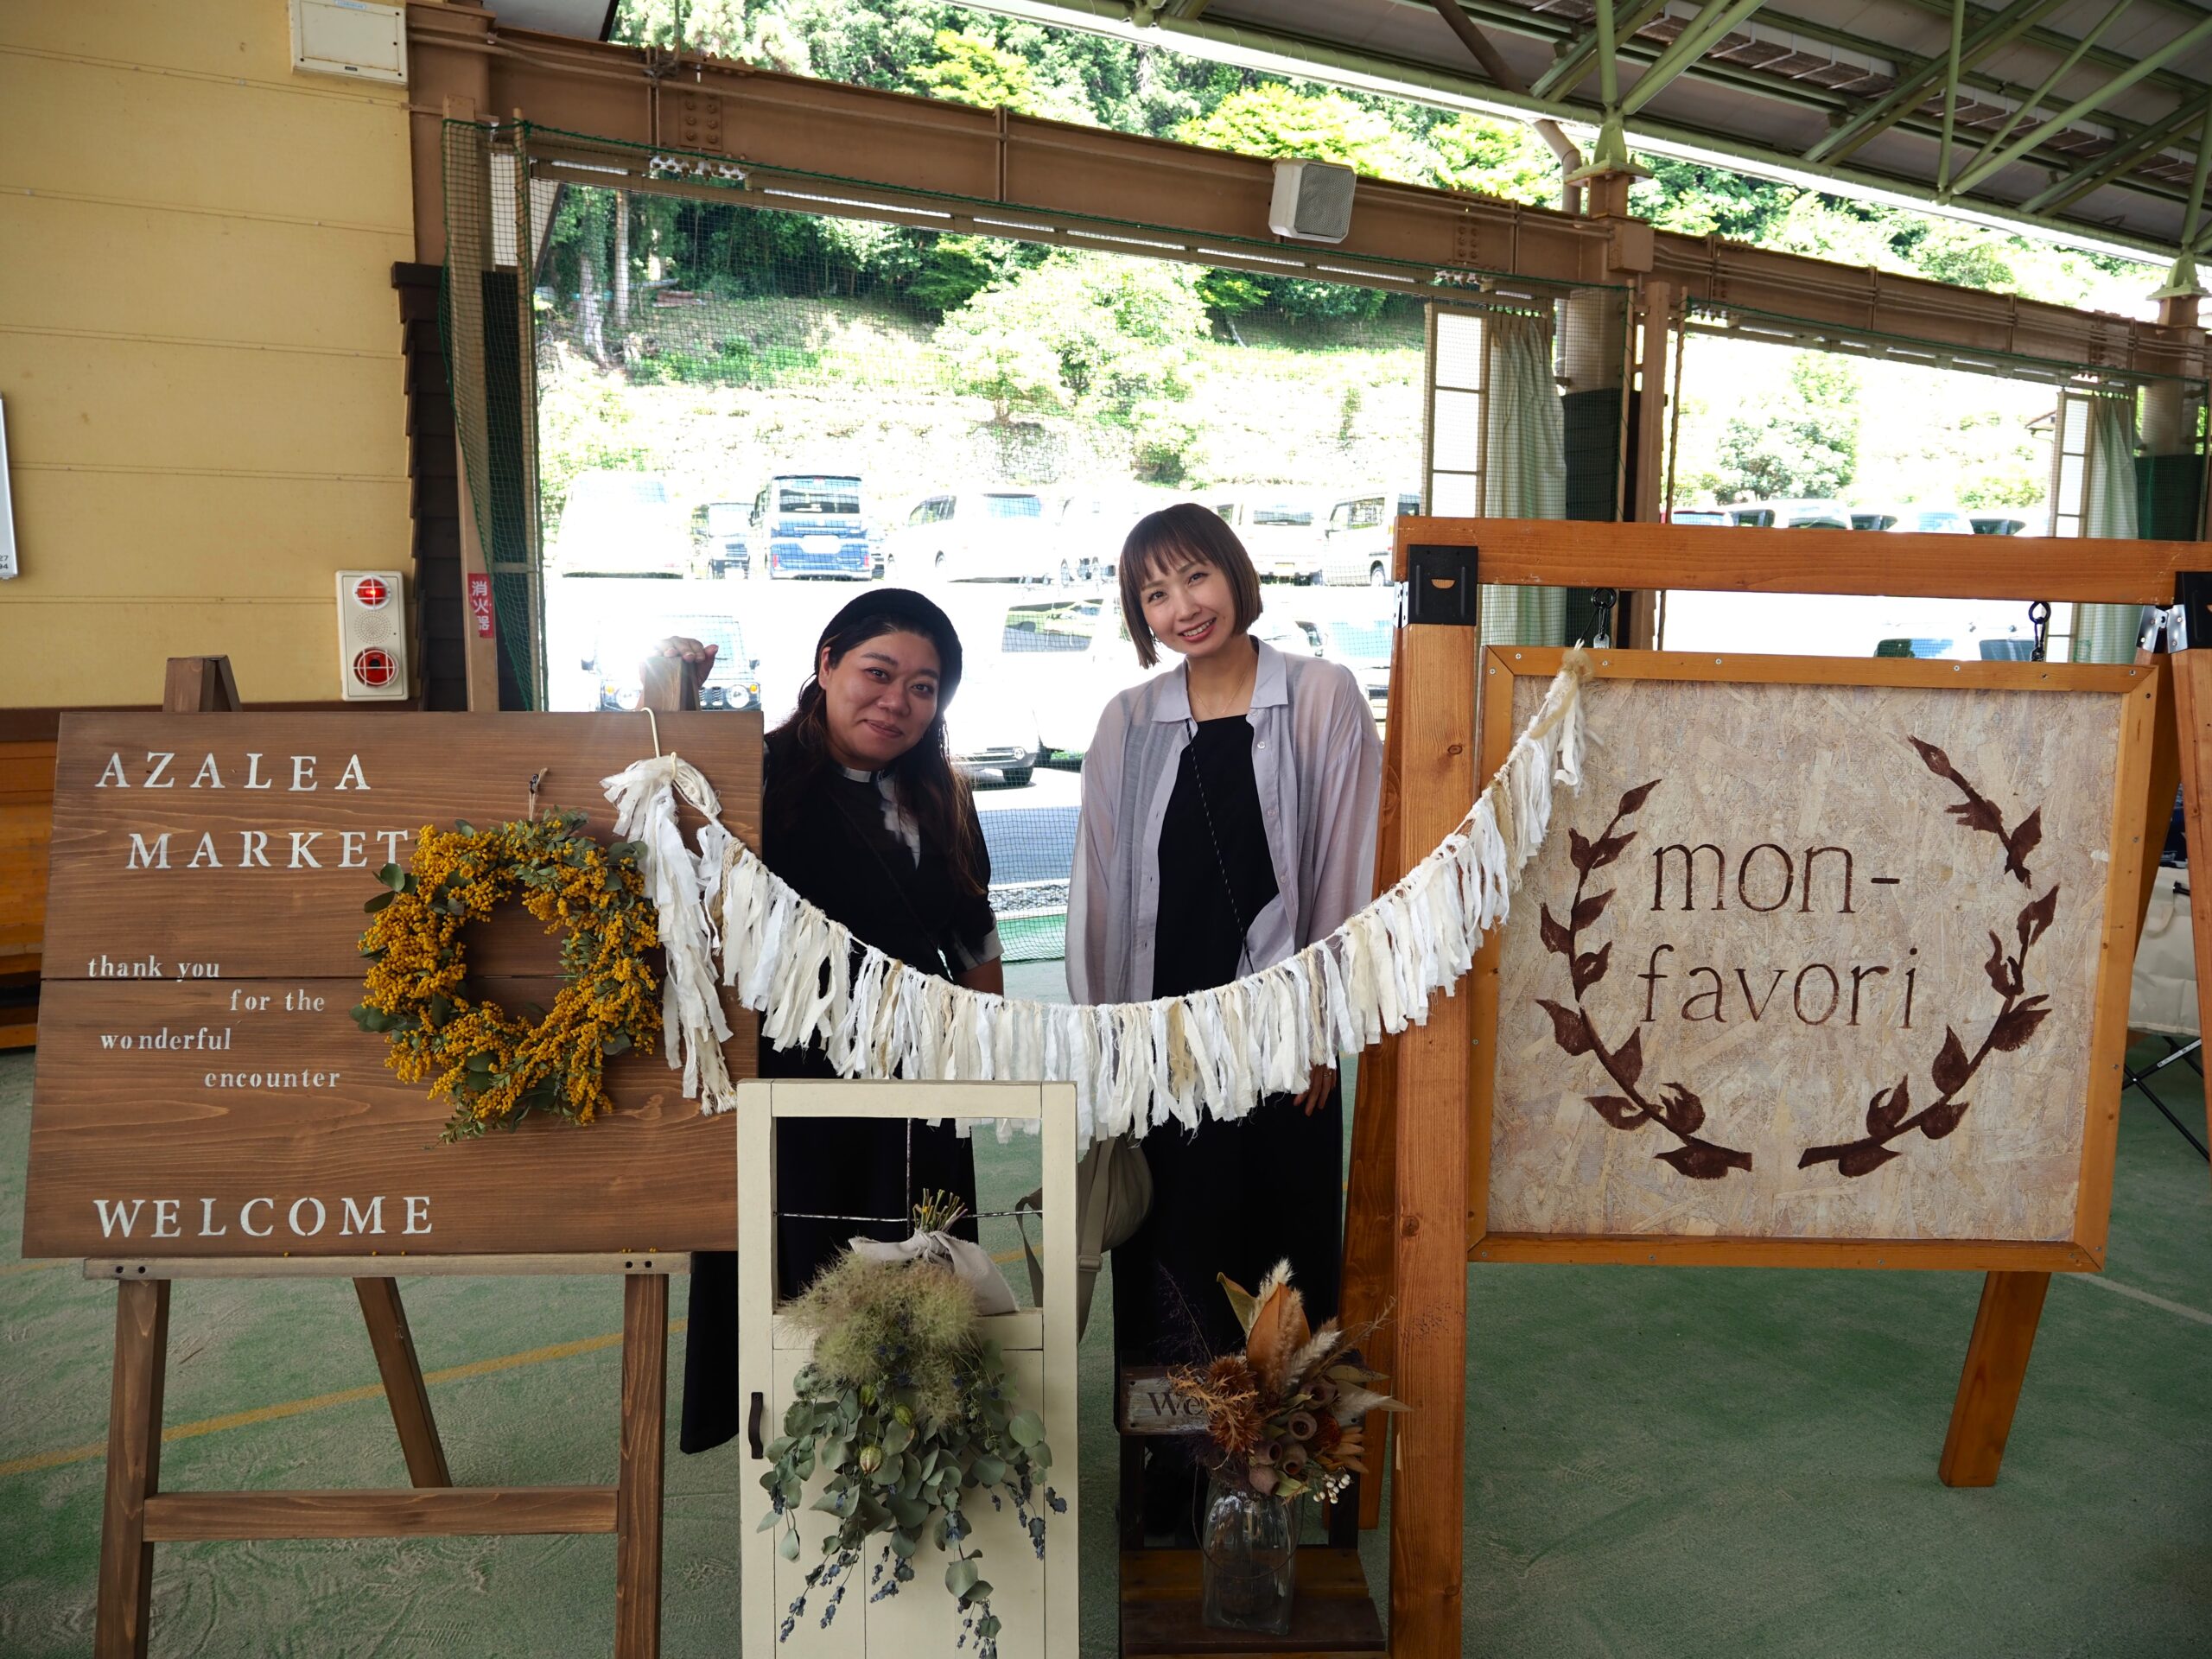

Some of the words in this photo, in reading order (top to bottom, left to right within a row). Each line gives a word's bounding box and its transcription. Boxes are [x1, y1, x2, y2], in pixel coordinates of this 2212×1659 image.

[95, 752, 372, 791] AZALEA
[126, 830, 409, 869] MARKET
[1650, 844, 1901, 913] mon-
[88, 955, 162, 977] thank
[177, 963, 219, 983] you
[1637, 944, 1917, 1028] favori
[230, 989, 271, 1011] for
[285, 989, 325, 1012] the
[100, 1027, 231, 1051] wonderful
[205, 1070, 340, 1088] encounter
[93, 1196, 433, 1238] WELCOME
